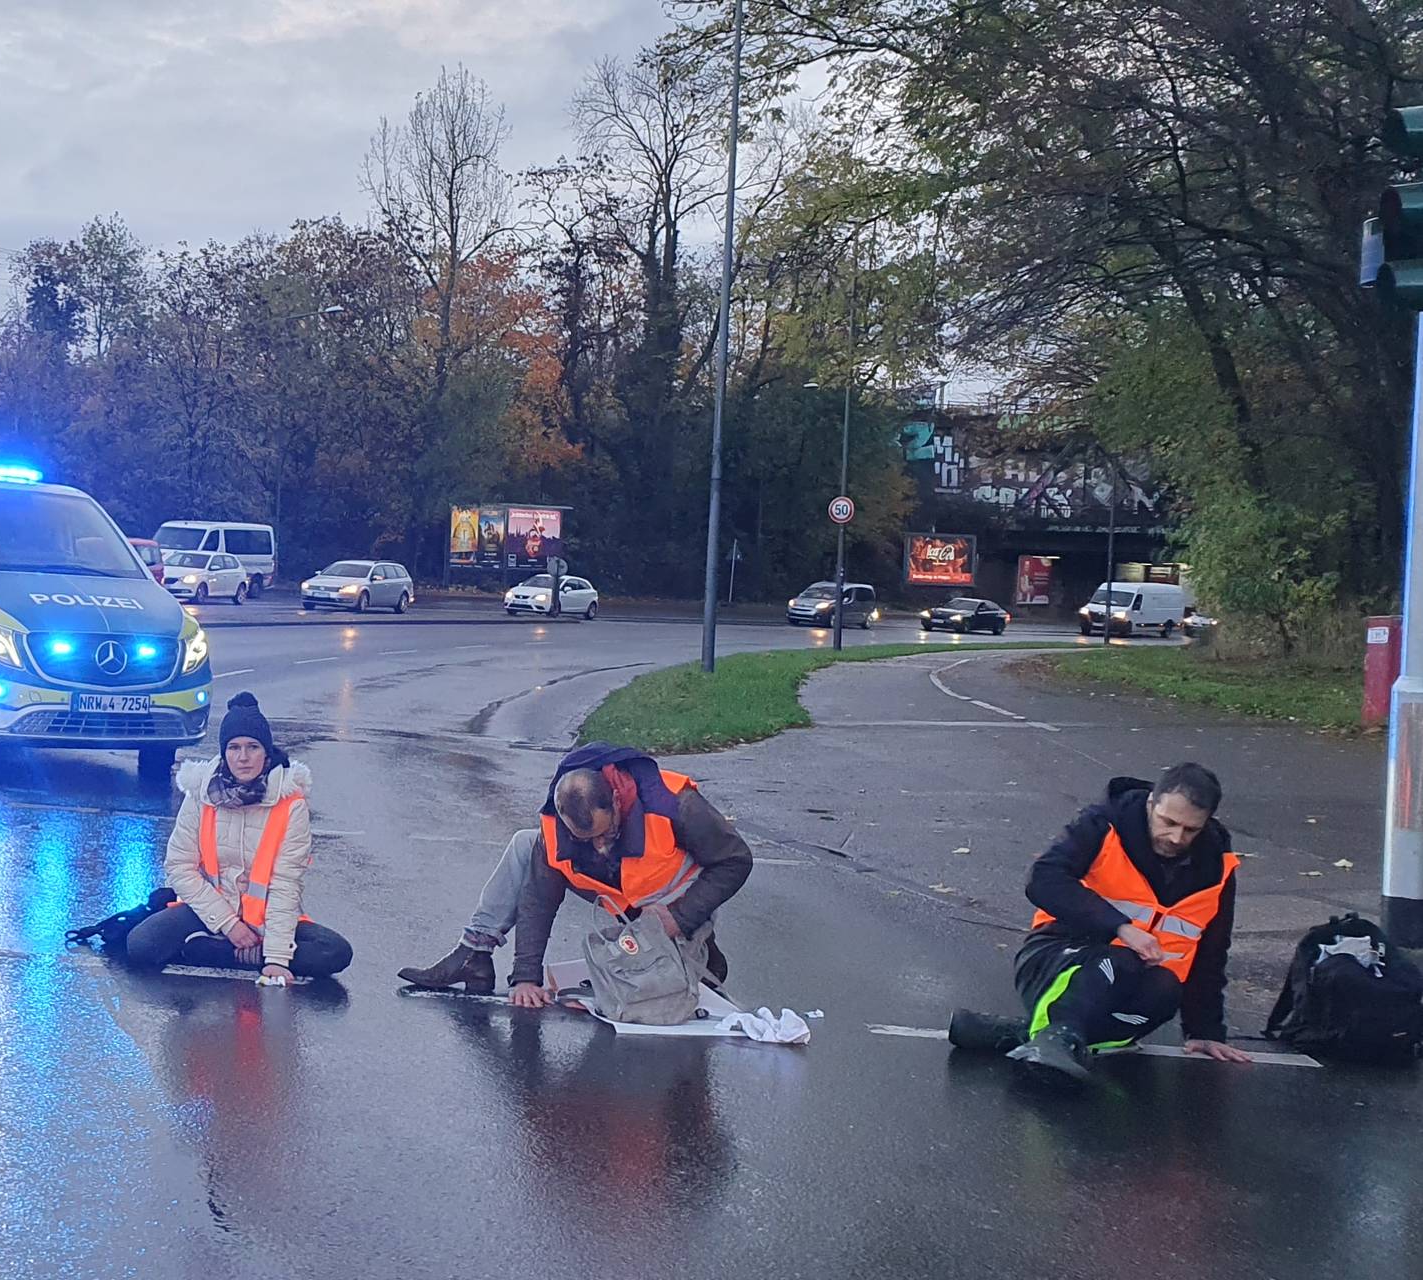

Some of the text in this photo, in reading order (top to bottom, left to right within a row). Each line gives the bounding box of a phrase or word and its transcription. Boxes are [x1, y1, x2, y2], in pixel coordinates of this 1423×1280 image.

[835, 504, 848, 516] 50
[29, 593, 145, 610] POLIZEI
[79, 695, 103, 711] NRW
[122, 697, 148, 712] 7254
